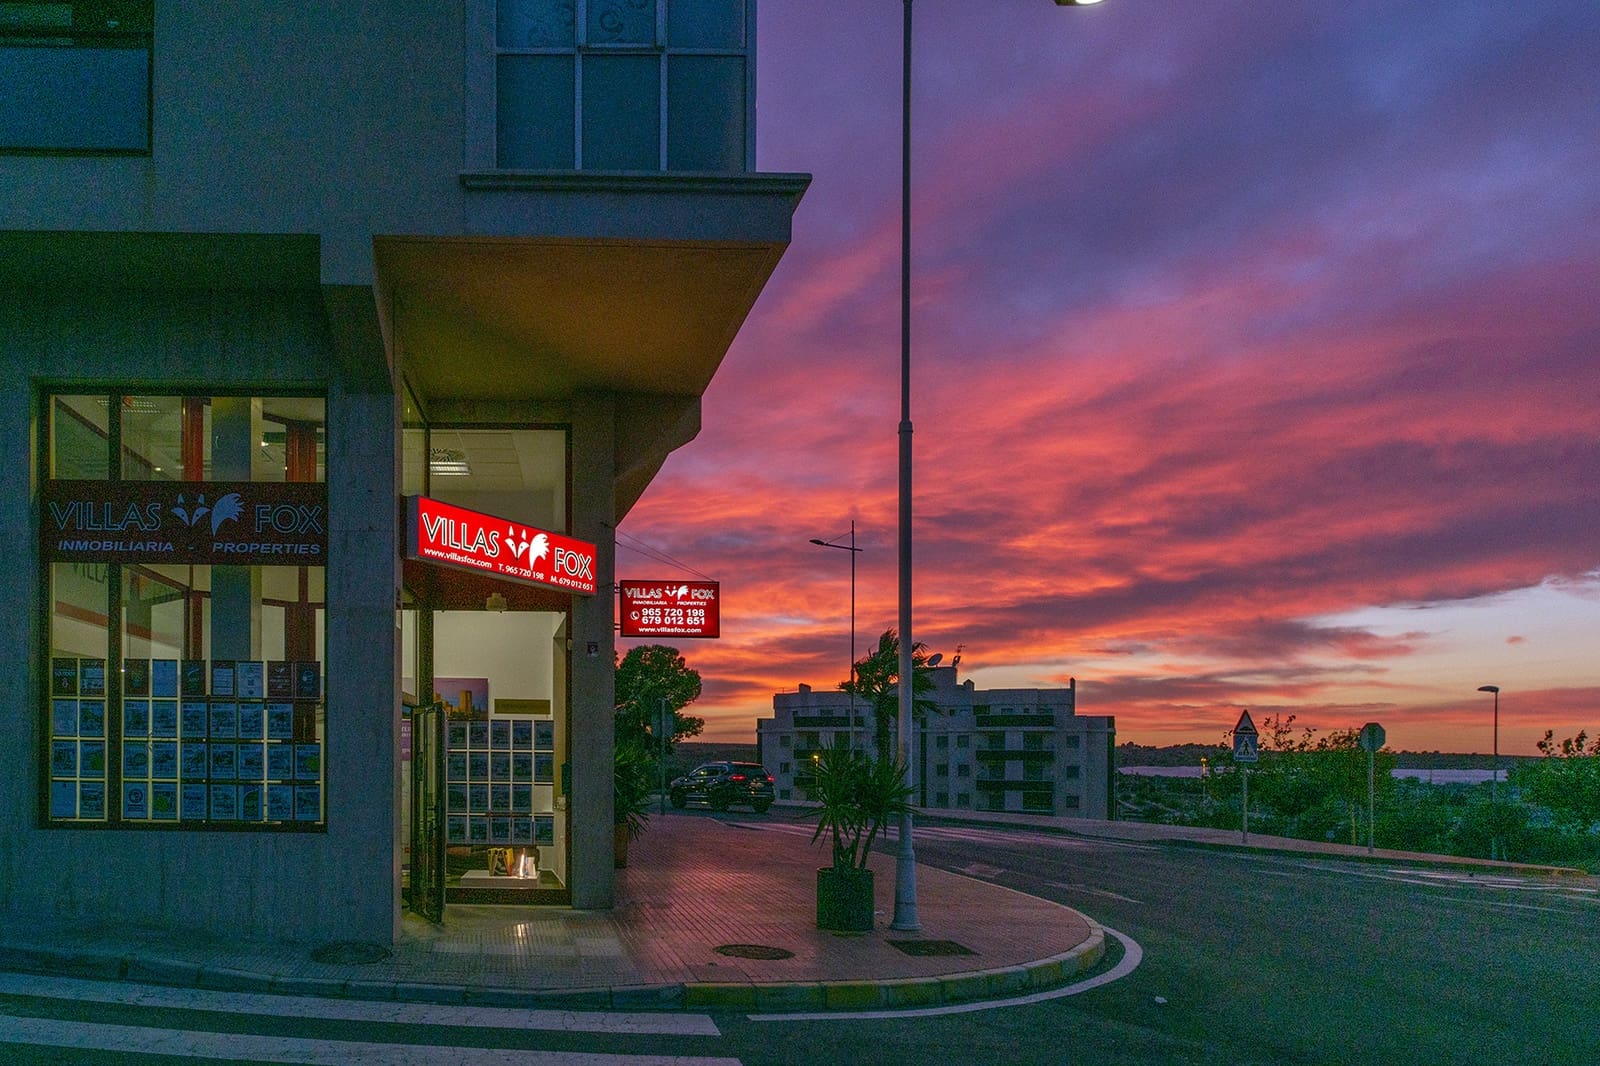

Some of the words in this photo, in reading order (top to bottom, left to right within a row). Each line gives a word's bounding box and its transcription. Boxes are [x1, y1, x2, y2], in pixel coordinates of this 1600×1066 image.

[50, 501, 161, 531] VILLAS
[255, 504, 324, 535] FOX
[58, 540, 174, 552] INMOBILIARIA
[212, 542, 321, 554] PROPERTIES
[422, 513, 500, 557] VILLAS
[554, 547, 593, 580] FOX
[424, 547, 493, 569] www.villasfox.com
[498, 563, 505, 572] T.
[505, 565, 518, 575] 965
[519, 567, 532, 577] 720
[532, 571, 545, 581] 198
[550, 575, 558, 584] M.
[558, 577, 571, 586] 679
[570, 580, 582, 589] 012
[582, 583, 593, 591] 651
[624, 587, 663, 599] VILLAS
[690, 588, 715, 600] FOX
[641, 608, 661, 616] 965
[663, 608, 683, 617] 720
[685, 608, 705, 617] 198
[641, 616, 661, 625] 679
[664, 616, 683, 625] 012
[686, 616, 705, 625] 651
